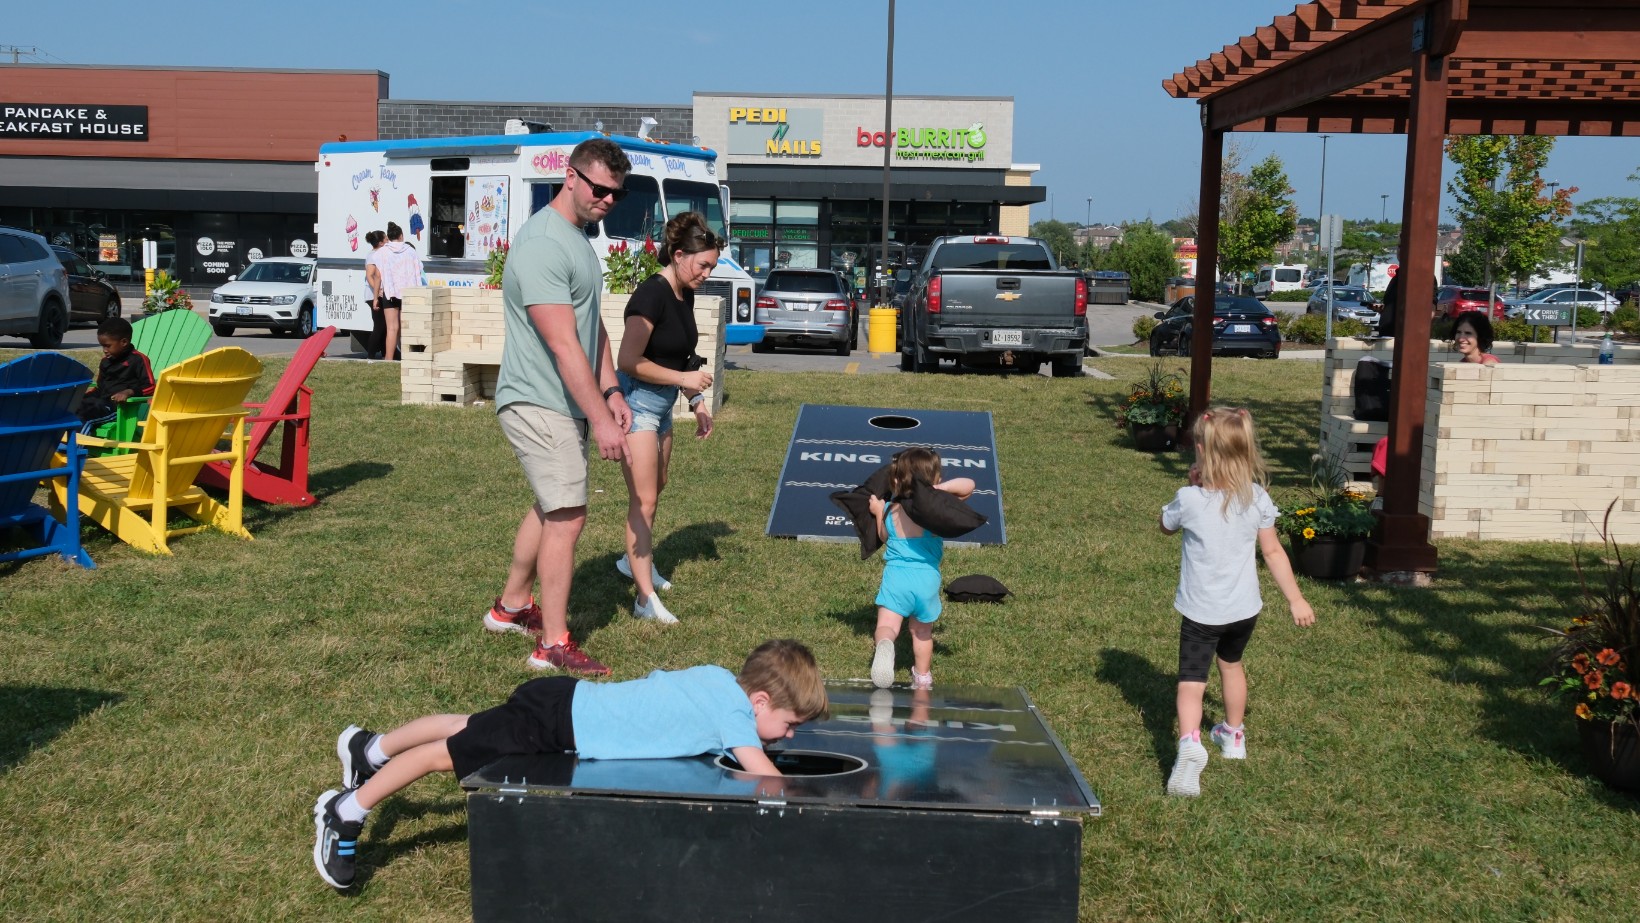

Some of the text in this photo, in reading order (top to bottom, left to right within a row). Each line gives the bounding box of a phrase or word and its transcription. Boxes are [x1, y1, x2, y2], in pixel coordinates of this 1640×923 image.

[4, 107, 108, 120] PANCAKE &
[729, 107, 787, 125] PEDI
[80, 123, 144, 135] HOUSE
[766, 139, 822, 158] NAILS
[628, 152, 692, 178] ream Team
[379, 164, 398, 190] Team
[731, 229, 769, 238] PEDICURE
[800, 451, 882, 464] KING
